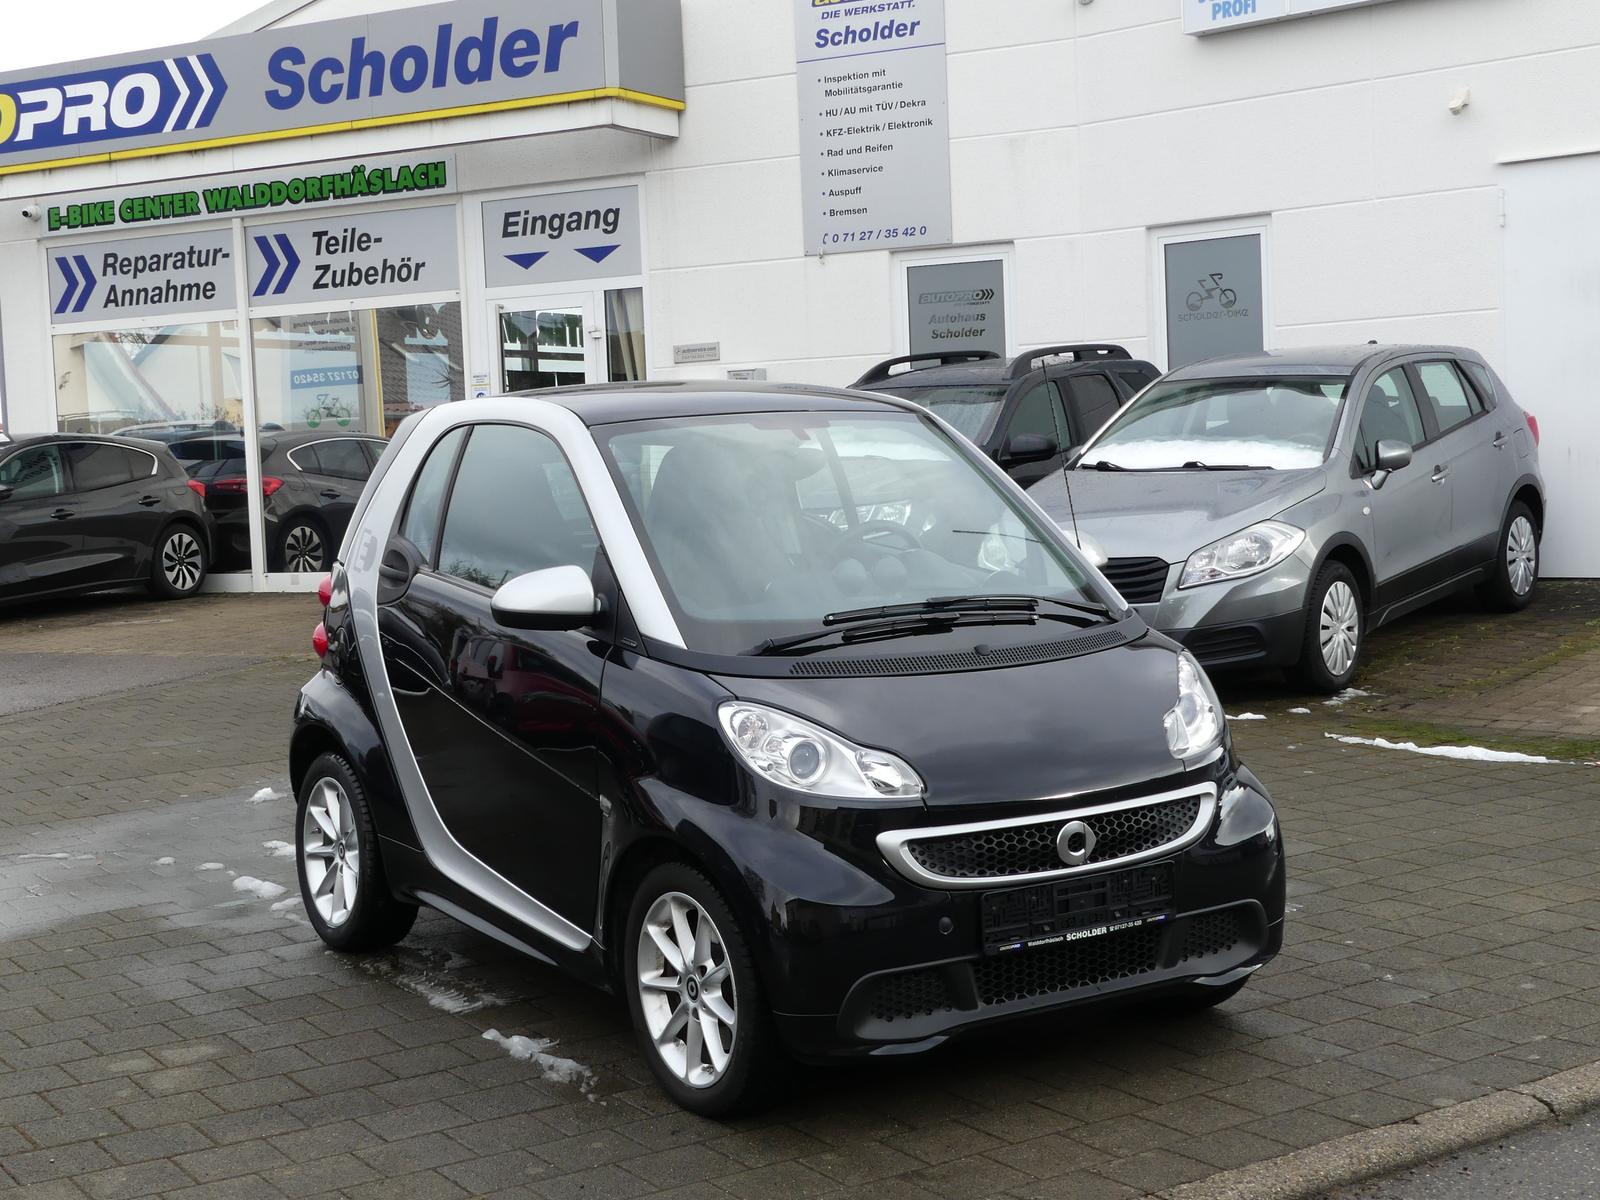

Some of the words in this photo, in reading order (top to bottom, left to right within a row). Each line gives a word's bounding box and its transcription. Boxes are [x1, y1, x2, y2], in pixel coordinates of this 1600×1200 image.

[821, 10, 841, 20] DIE
[1211, 0, 1257, 20] PROFI
[815, 19, 921, 48] Scholder
[264, 16, 579, 111] Scholder
[824, 71, 869, 84] Inspektion
[871, 69, 886, 78] mit
[824, 81, 904, 98] Mobilitätsgarantie
[859, 103, 873, 113] mit
[827, 148, 844, 157] Rad
[846, 145, 863, 155] und
[865, 143, 894, 153] Reifen
[827, 164, 884, 177] Klimaservice
[48, 200, 116, 231] E-BIKE
[119, 190, 201, 223] CENTER
[202, 161, 447, 214] WALDDORFHÄSLACH
[828, 186, 862, 197] Auspuff
[829, 207, 868, 217] Bremsen
[501, 204, 621, 239] Eingang
[312, 227, 383, 256] Teile-
[102, 245, 230, 279] Reparatur-
[312, 257, 426, 290] Zubehör
[103, 280, 216, 308] Annahme
[928, 313, 986, 325] Autohaus
[931, 327, 986, 339] Scholder
[1066, 926, 1107, 942] SCHOLDER
